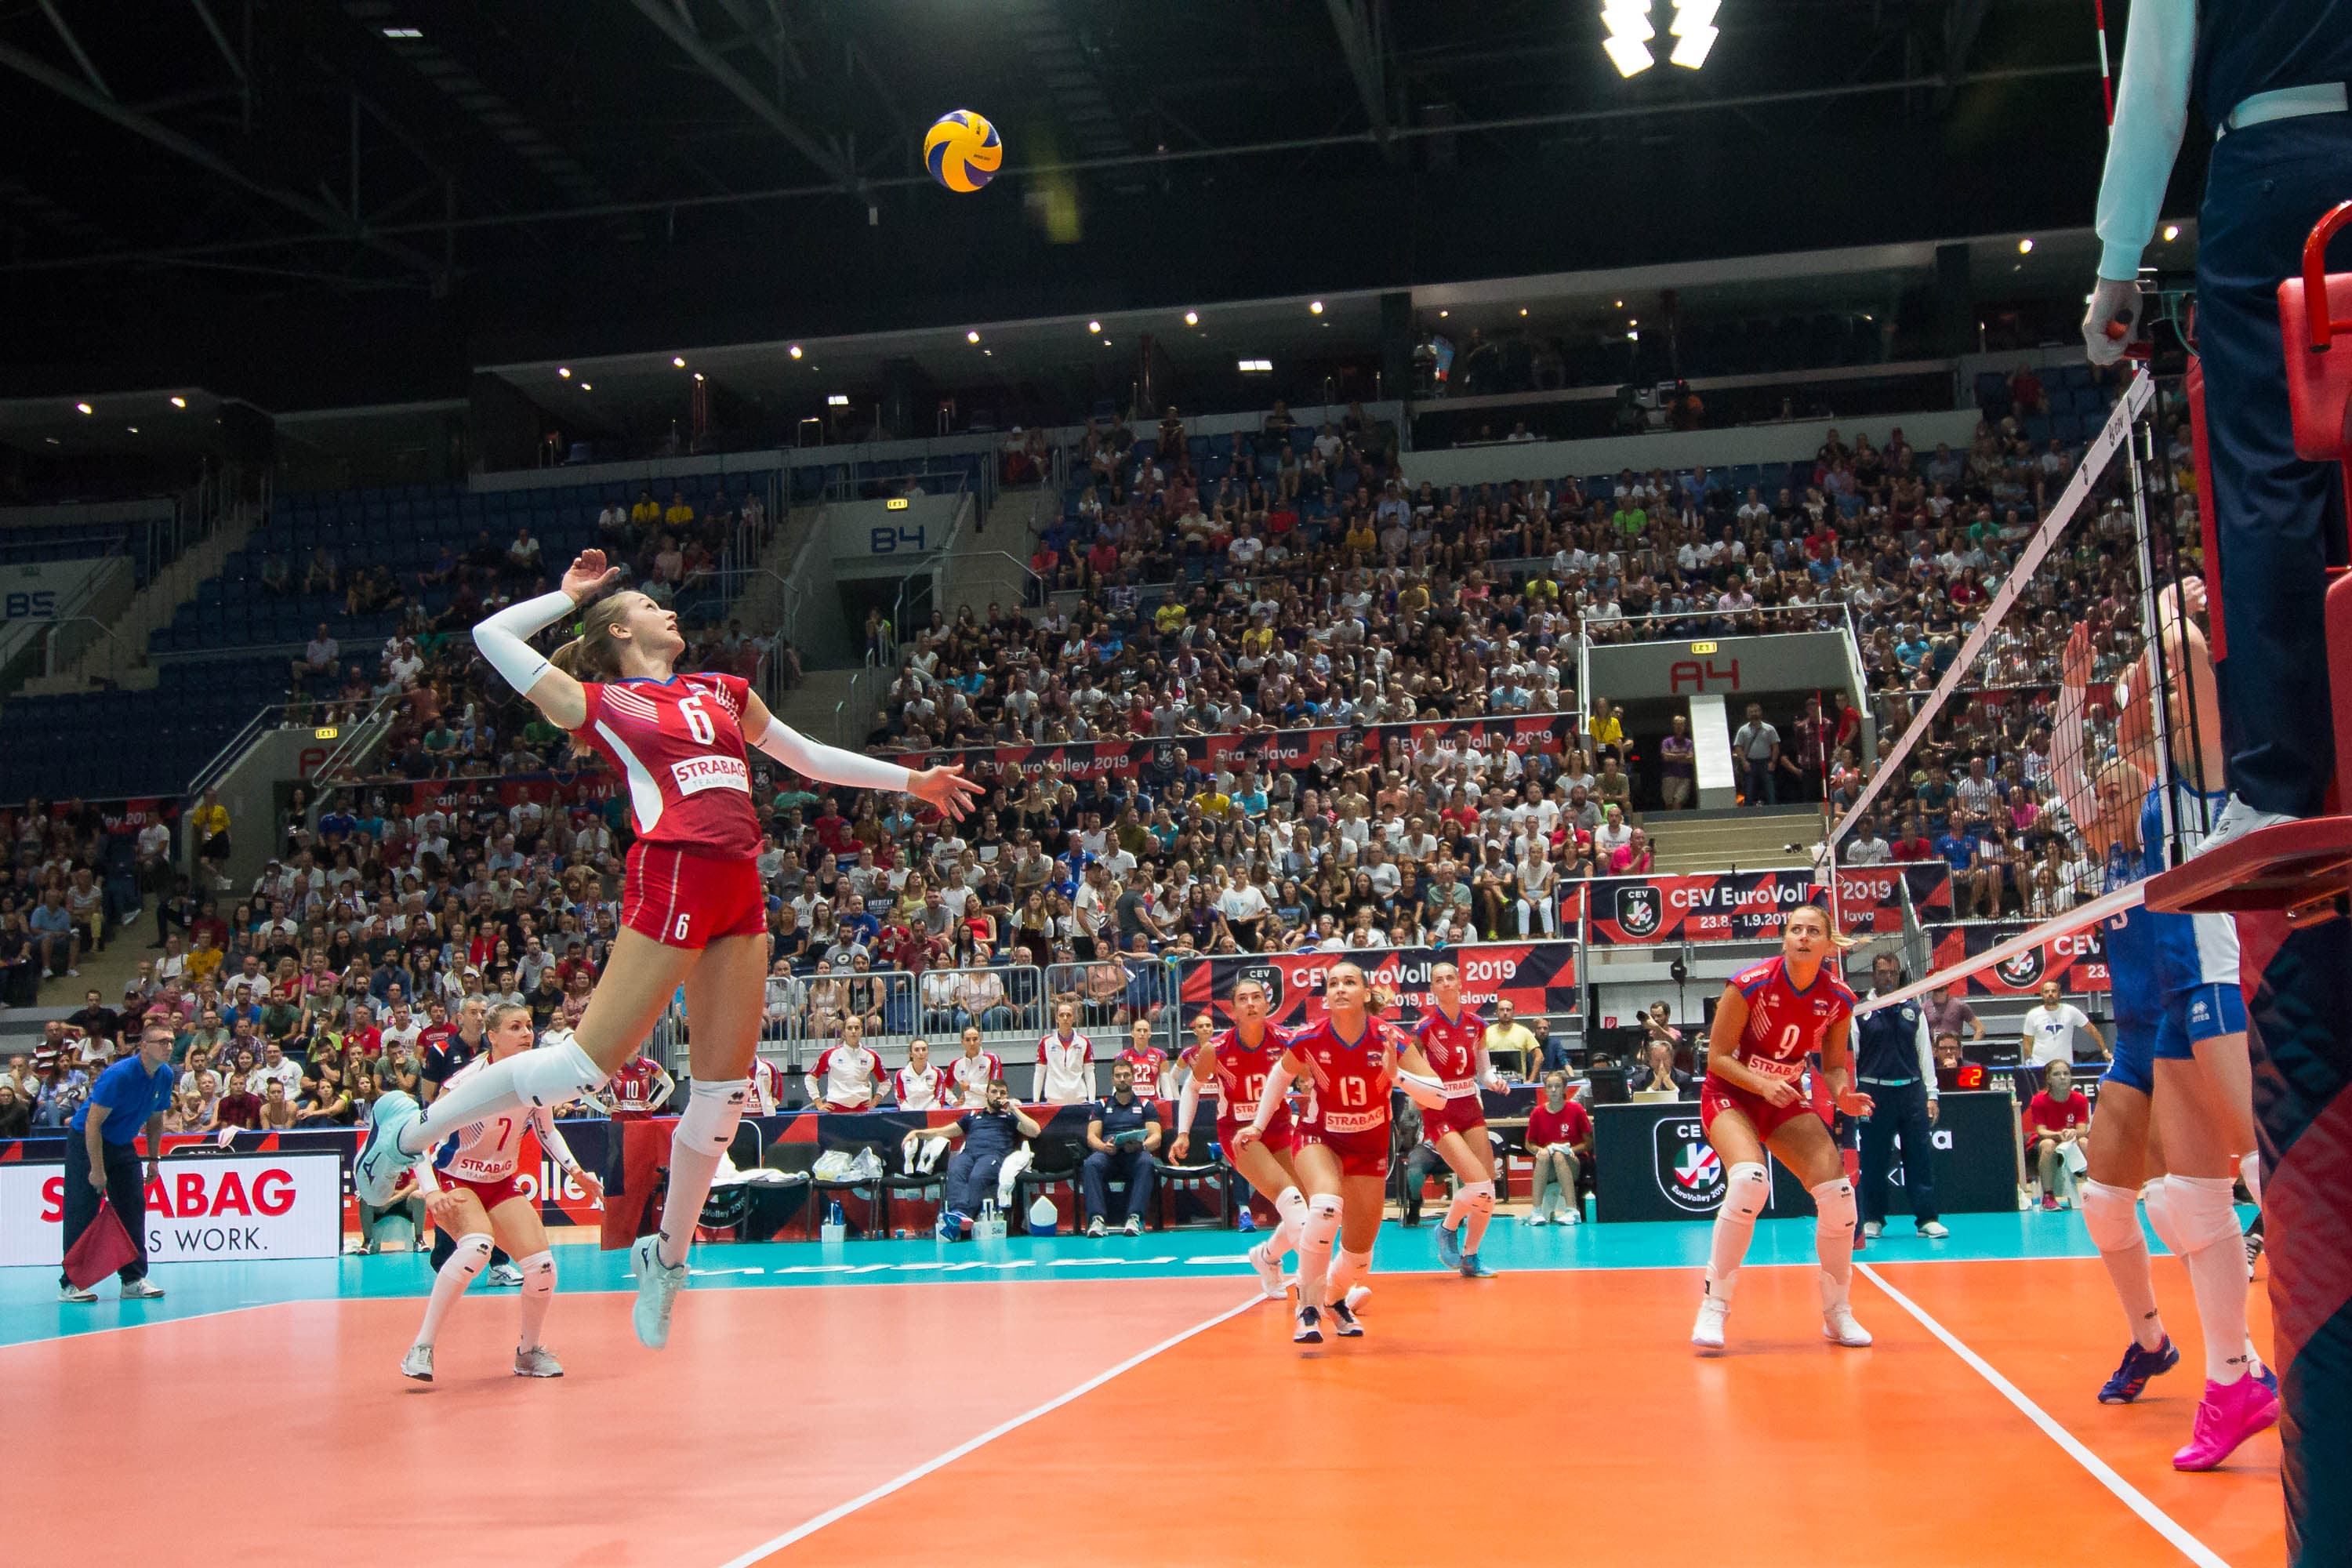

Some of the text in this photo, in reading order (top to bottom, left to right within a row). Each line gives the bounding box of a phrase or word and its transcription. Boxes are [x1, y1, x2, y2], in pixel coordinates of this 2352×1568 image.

[872, 524, 925, 554] B4
[1670, 659, 1740, 694] A4
[677, 695, 716, 746] 6
[677, 760, 746, 782] STRABAG
[1094, 754, 1129, 770] 2019
[1670, 888, 1715, 908] CEV
[1842, 880, 1891, 900] 2019
[674, 913, 691, 940] 6
[1250, 969, 1270, 978] CEV
[1465, 960, 1517, 982] 2019
[1774, 1025, 1801, 1060] 9
[1133, 1063, 1151, 1083] 22
[1455, 1046, 1468, 1075] 3
[626, 1080, 639, 1099] 10
[1245, 1073, 1267, 1102] 12
[1339, 1076, 1367, 1106] 13
[1327, 1109, 1385, 1125] STRABAG
[498, 1117, 512, 1152] 7
[1676, 1124, 1702, 1138] CE
[460, 1158, 513, 1174] STRABAG
[40, 1168, 297, 1224] SABAG
[1671, 1185, 1711, 1203] EuroVolley
[175, 1226, 267, 1252] WORK.
